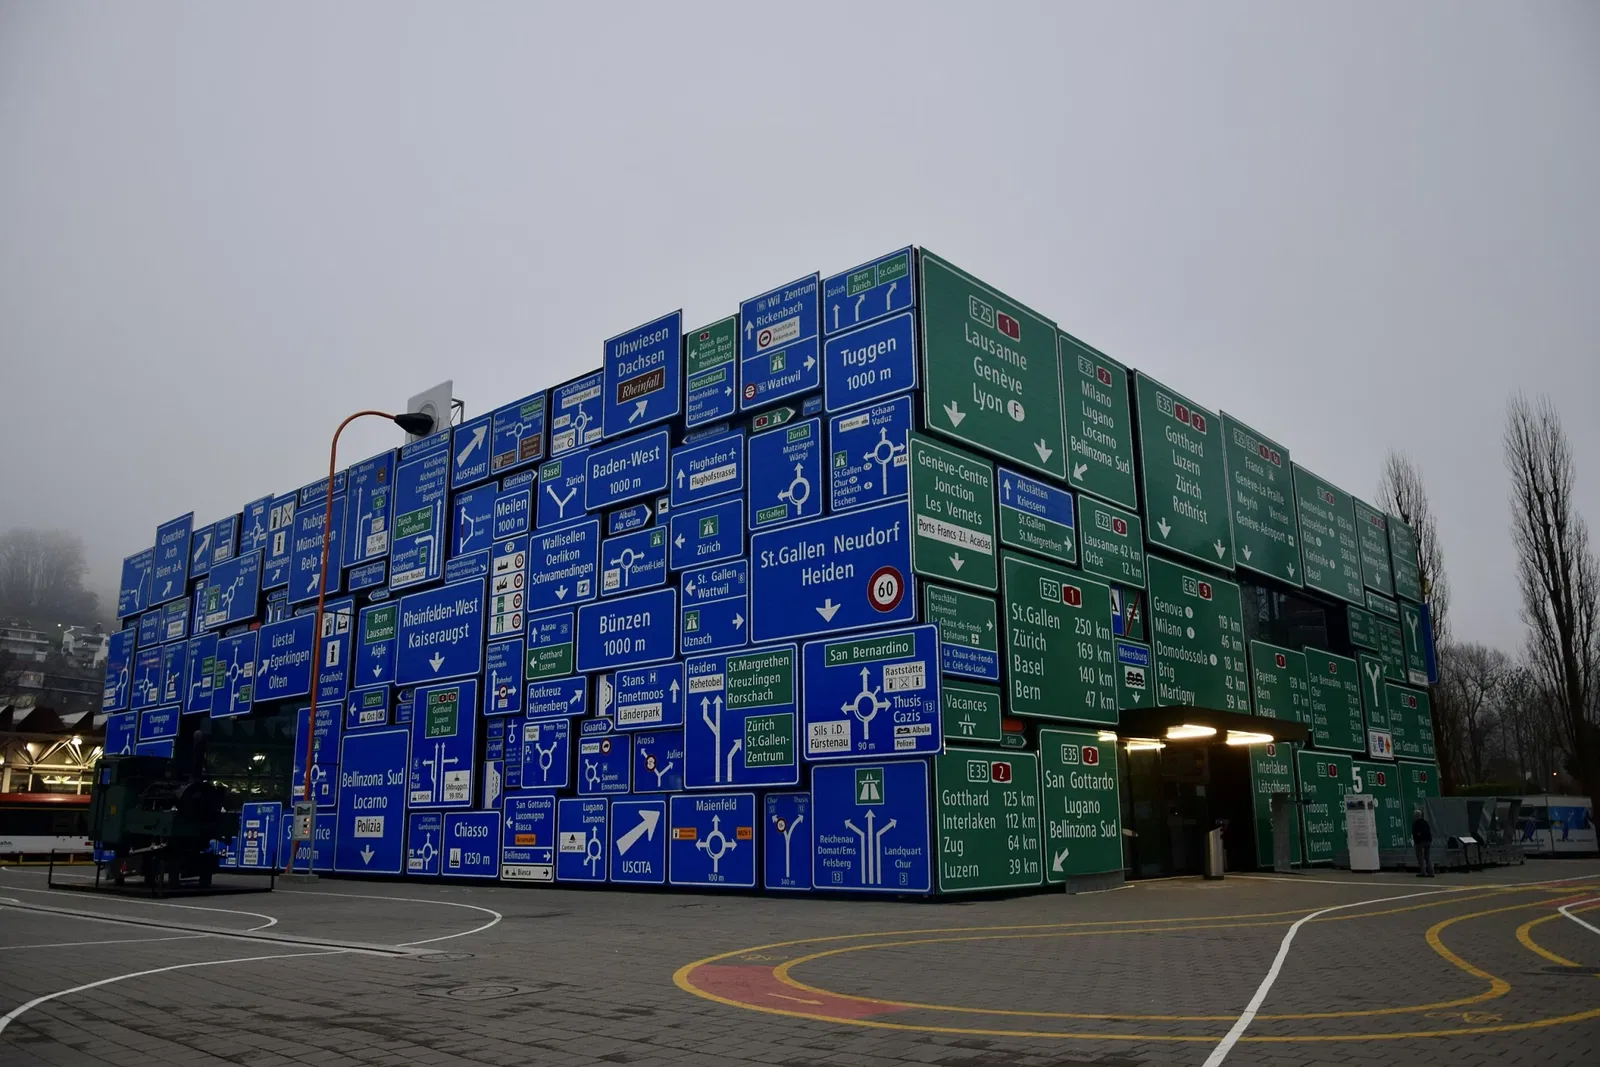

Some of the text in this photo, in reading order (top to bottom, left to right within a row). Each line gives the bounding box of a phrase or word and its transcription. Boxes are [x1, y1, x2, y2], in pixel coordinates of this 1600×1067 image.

[854, 271, 869, 283] Bern
[827, 284, 845, 297] Zürich
[852, 280, 871, 292] Zürich
[615, 327, 669, 359] Uhwiesen
[965, 323, 1027, 370] Lausanne
[841, 337, 897, 367] Tuggen
[618, 350, 665, 377] Dachsen
[847, 368, 891, 391] 1000 m
[973, 356, 1023, 395] Genève
[622, 373, 660, 400] Rheinfall
[1082, 381, 1112, 407] Milano
[973, 383, 1003, 414] Lyon
[872, 405, 895, 417] Schaan
[1082, 401, 1114, 428] Lugano
[872, 415, 892, 426] Vaduz
[789, 428, 808, 440] Zürich
[1083, 423, 1116, 449] Locarno
[1165, 426, 1203, 457] Gotthard
[593, 446, 659, 479] Baden-West
[690, 453, 727, 471] Flughafen
[789, 451, 808, 462] Wängi
[1071, 436, 1129, 474] Bellinzona Sud
[1173, 450, 1200, 476] Luzern
[455, 462, 486, 481] AUSFAHRT
[543, 466, 559, 477] Basel
[918, 450, 988, 488] Genève-Centre
[1245, 457, 1264, 477] France
[566, 474, 584, 487] Zürich
[691, 467, 735, 486] Flughofstrasse
[834, 485, 862, 497] Feldkirch
[935, 476, 974, 503] Jonction
[1017, 479, 1048, 500] Altstätten
[1176, 474, 1201, 500] Zürich
[497, 497, 527, 518] Meilen
[834, 496, 856, 507] Eschen
[1017, 495, 1046, 514] Kriessern
[1237, 491, 1288, 525] Meyrin Vernier
[619, 509, 636, 520] Albula
[759, 509, 785, 521] St.Gallen
[926, 495, 983, 525] Les Vernets
[1173, 496, 1207, 524] Rothrist
[498, 518, 524, 533] 1000 m
[542, 529, 586, 550] Wallisellen
[761, 521, 900, 569] St.Gallen Neudorf
[697, 542, 721, 555] Zürich
[546, 548, 580, 566] Oerlikon
[533, 562, 593, 585] Schwamendingen
[802, 563, 854, 587] Heiden
[698, 585, 729, 599] Wattwil
[403, 597, 478, 628] Rheinfelden-West
[1154, 596, 1183, 617] Genova
[374, 613, 387, 623] Bern
[600, 611, 651, 635] Bünzen
[1012, 602, 1110, 640] St.Gallen 250 km
[367, 626, 393, 640] Lausanne
[1155, 617, 1182, 637] Milano
[272, 629, 295, 648] Liestal
[408, 623, 469, 649] Kaiseraugst
[684, 633, 712, 647] Uznach
[371, 645, 386, 658] Aigle
[830, 642, 909, 662] San Bernardino
[1013, 629, 1111, 663] Zürich 169 km
[1157, 640, 1208, 665] Domodossola
[270, 649, 309, 670] Egerkingen
[539, 649, 563, 660] Gotthard
[539, 662, 556, 671] Luzern
[689, 661, 716, 674] Heiden
[728, 655, 789, 674] St.Margrethen
[885, 665, 923, 675] Raststätte
[1015, 654, 1113, 687] Basel 140 km
[1159, 662, 1175, 681] Brig
[269, 676, 287, 689] Olten
[320, 671, 343, 683] Grauholz
[622, 674, 645, 687] Stans
[690, 676, 722, 688] Rehetobel
[728, 672, 781, 689] Kreuzlingen
[1256, 667, 1277, 684] Payerne
[365, 693, 381, 705] Luzern
[530, 685, 562, 697] Rotkreuz
[618, 688, 664, 704] Ennetmoos
[728, 689, 773, 704] Rorschach
[1016, 679, 1114, 711] Bern 47 km
[1160, 683, 1195, 706] Martigny
[530, 701, 568, 714] Hünenberg
[893, 695, 921, 709] Thusis
[946, 693, 987, 712] Vacances
[433, 706, 452, 715] Gotthard
[620, 707, 660, 721] Länderpark
[894, 711, 920, 723] Cazis
[584, 721, 607, 733] Guarda
[747, 719, 775, 732] Zürich
[637, 736, 655, 745] Arosa
[811, 738, 849, 749] Fürstenau
[747, 750, 784, 763] Zentrum
[1257, 761, 1288, 775] Interlaken
[342, 768, 404, 788] Bellinzona Sud
[1046, 771, 1114, 790] San Gottardo
[1352, 766, 1363, 793] 5
[354, 795, 388, 810] Locarno
[516, 800, 551, 809] San Gottardo
[696, 798, 737, 812] Maienfeld
[943, 789, 1035, 806] Gotthard 125 km
[583, 802, 603, 813] Lugano
[1065, 796, 1100, 818] Lugano
[516, 812, 544, 820] Lucomagno
[582, 814, 605, 823] Lamone
[943, 813, 1036, 829] Interlaken 112 km
[357, 820, 381, 833] Polizia
[454, 822, 488, 837] Chiasso
[1050, 820, 1116, 838] Bellinzona Sud
[820, 835, 854, 844] Reichenau
[944, 835, 1037, 856] Zug 64 km
[464, 852, 490, 865] 1250 m
[504, 851, 530, 860] Bellinzona
[818, 846, 856, 855] Domat/Ems
[885, 846, 921, 857] Landquart
[622, 860, 651, 874] USCITA
[823, 858, 851, 869] Felsberg
[895, 859, 911, 869] Chur
[945, 859, 1038, 878] Luzern 39 km
